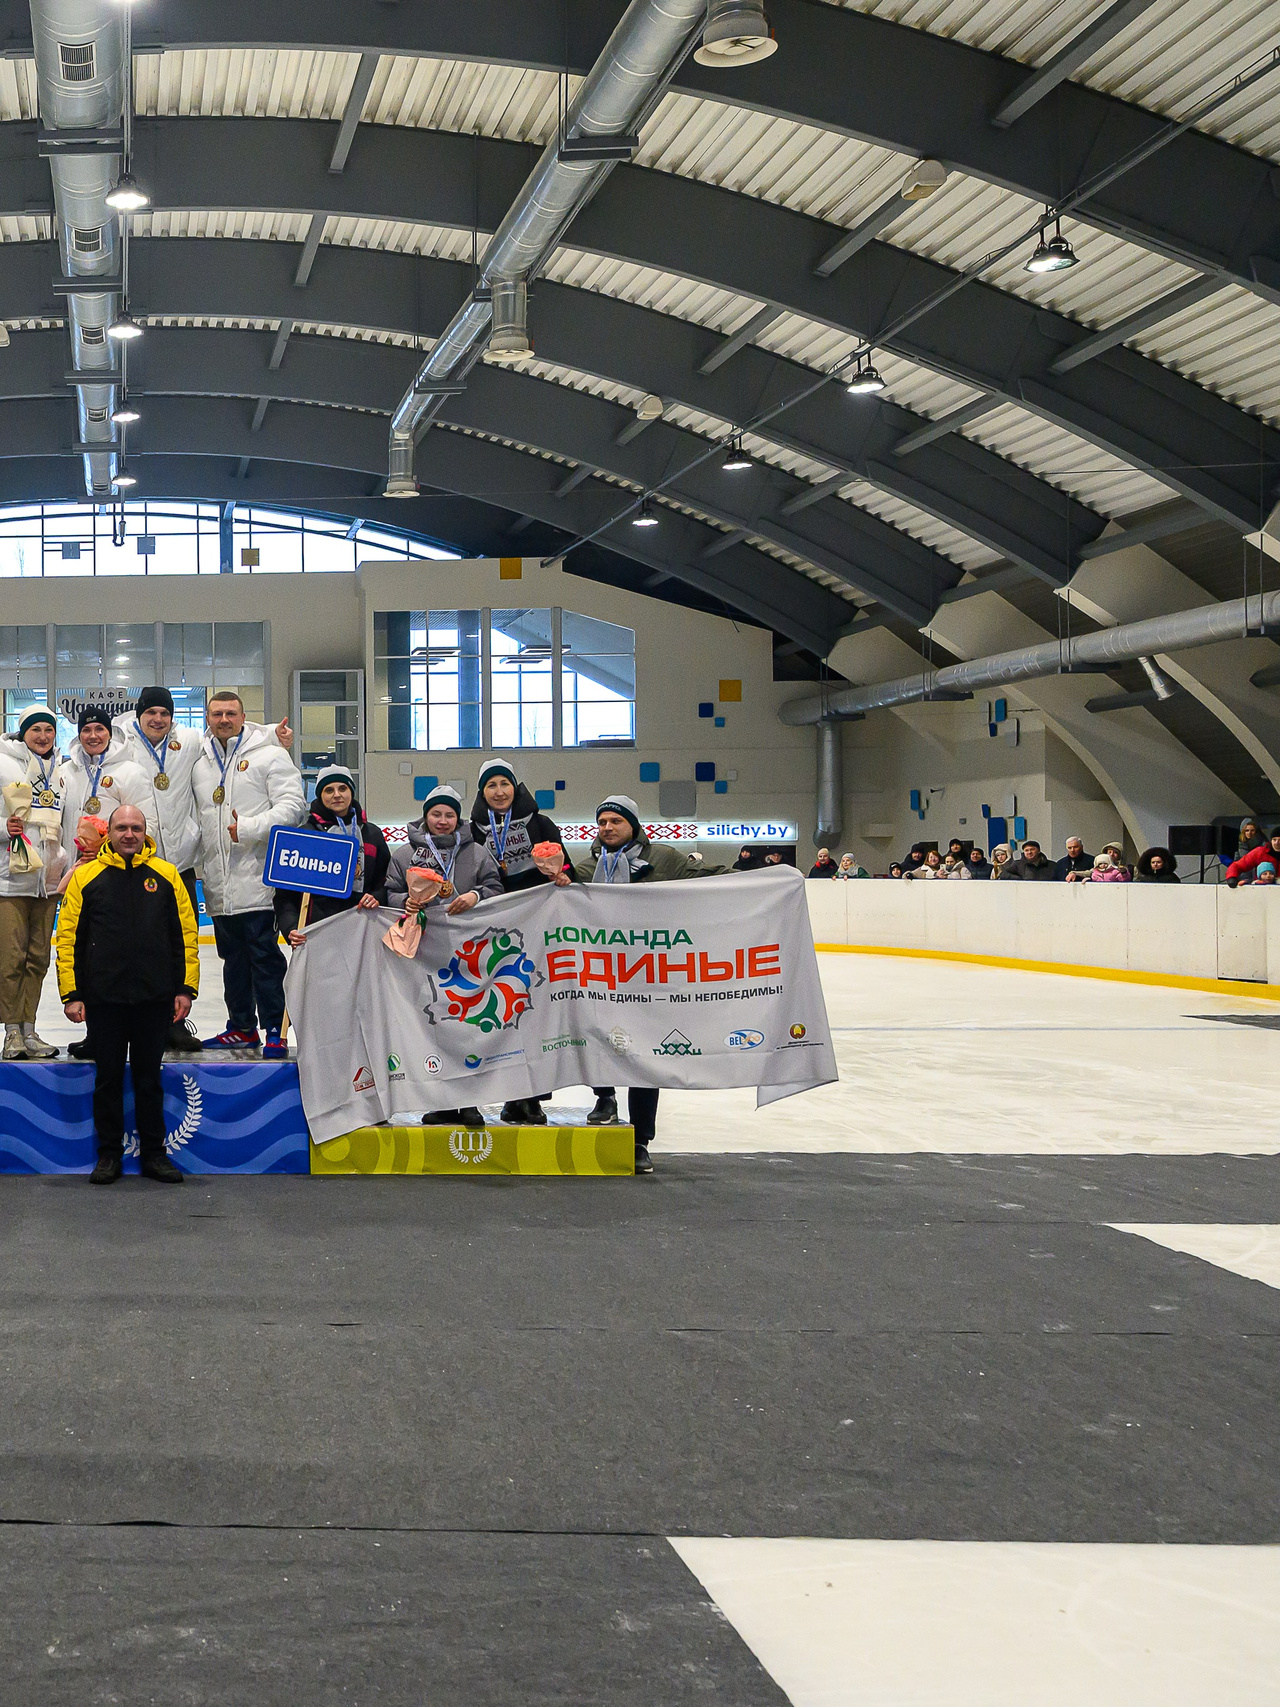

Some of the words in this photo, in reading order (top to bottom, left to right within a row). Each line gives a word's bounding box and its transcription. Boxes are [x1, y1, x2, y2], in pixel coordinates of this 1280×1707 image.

[89, 691, 124, 699] КАФЕ
[707, 824, 788, 838] silichy.by
[278, 848, 342, 875] Единые
[543, 926, 694, 950] КОМАНДА
[546, 943, 781, 991] ЕДИНЫЕ
[550, 990, 585, 1002] КОГДА
[588, 991, 607, 1001] МЫ
[609, 993, 652, 1004] ЕДИНЫ
[669, 993, 692, 1003] МЫ
[695, 985, 783, 1002] НЕПОБЕДИМЫ!
[456, 1131, 486, 1151] III
